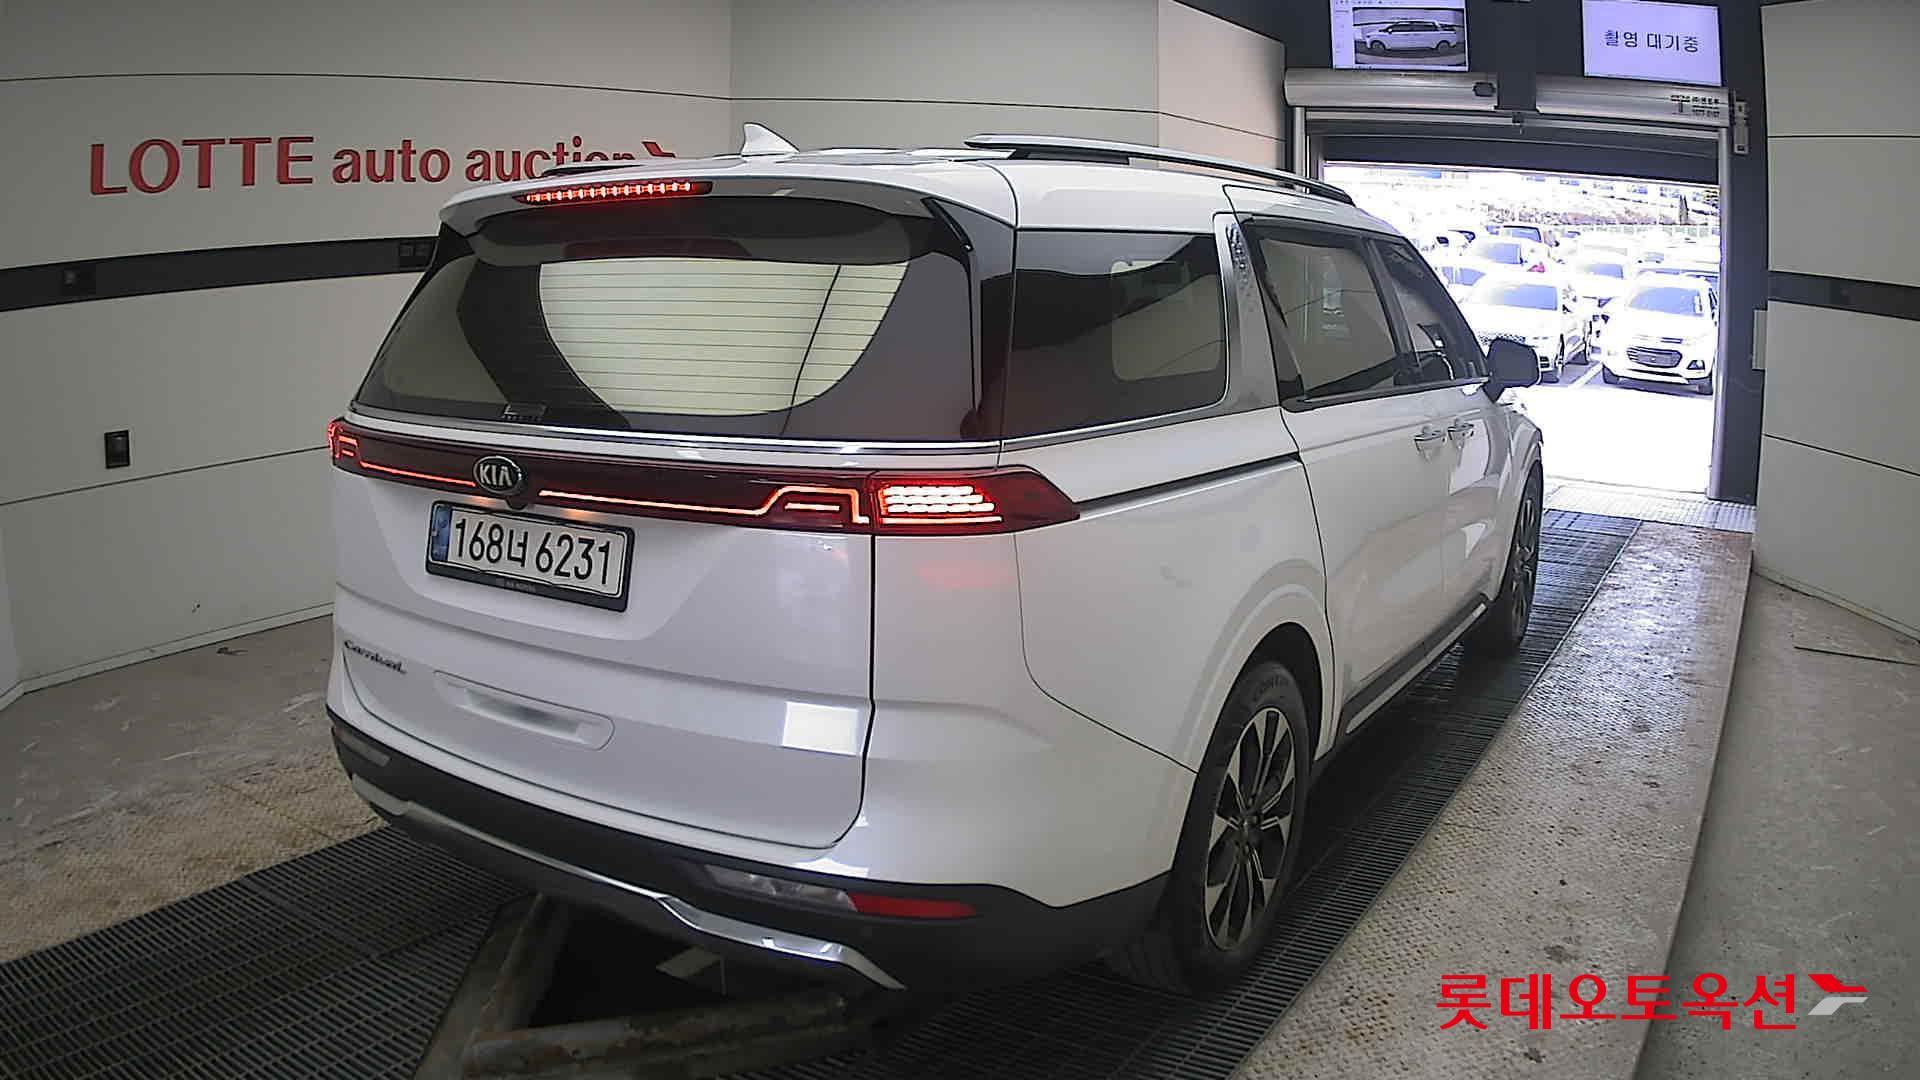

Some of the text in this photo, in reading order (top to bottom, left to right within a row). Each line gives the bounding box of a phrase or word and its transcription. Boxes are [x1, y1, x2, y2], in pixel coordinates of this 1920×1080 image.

[1604, 30, 1699, 53] 촬영 대기중
[91, 135, 636, 195] LOTTE auto aucti
[479, 462, 513, 487] KIA
[455, 518, 611, 585] 168너 6231
